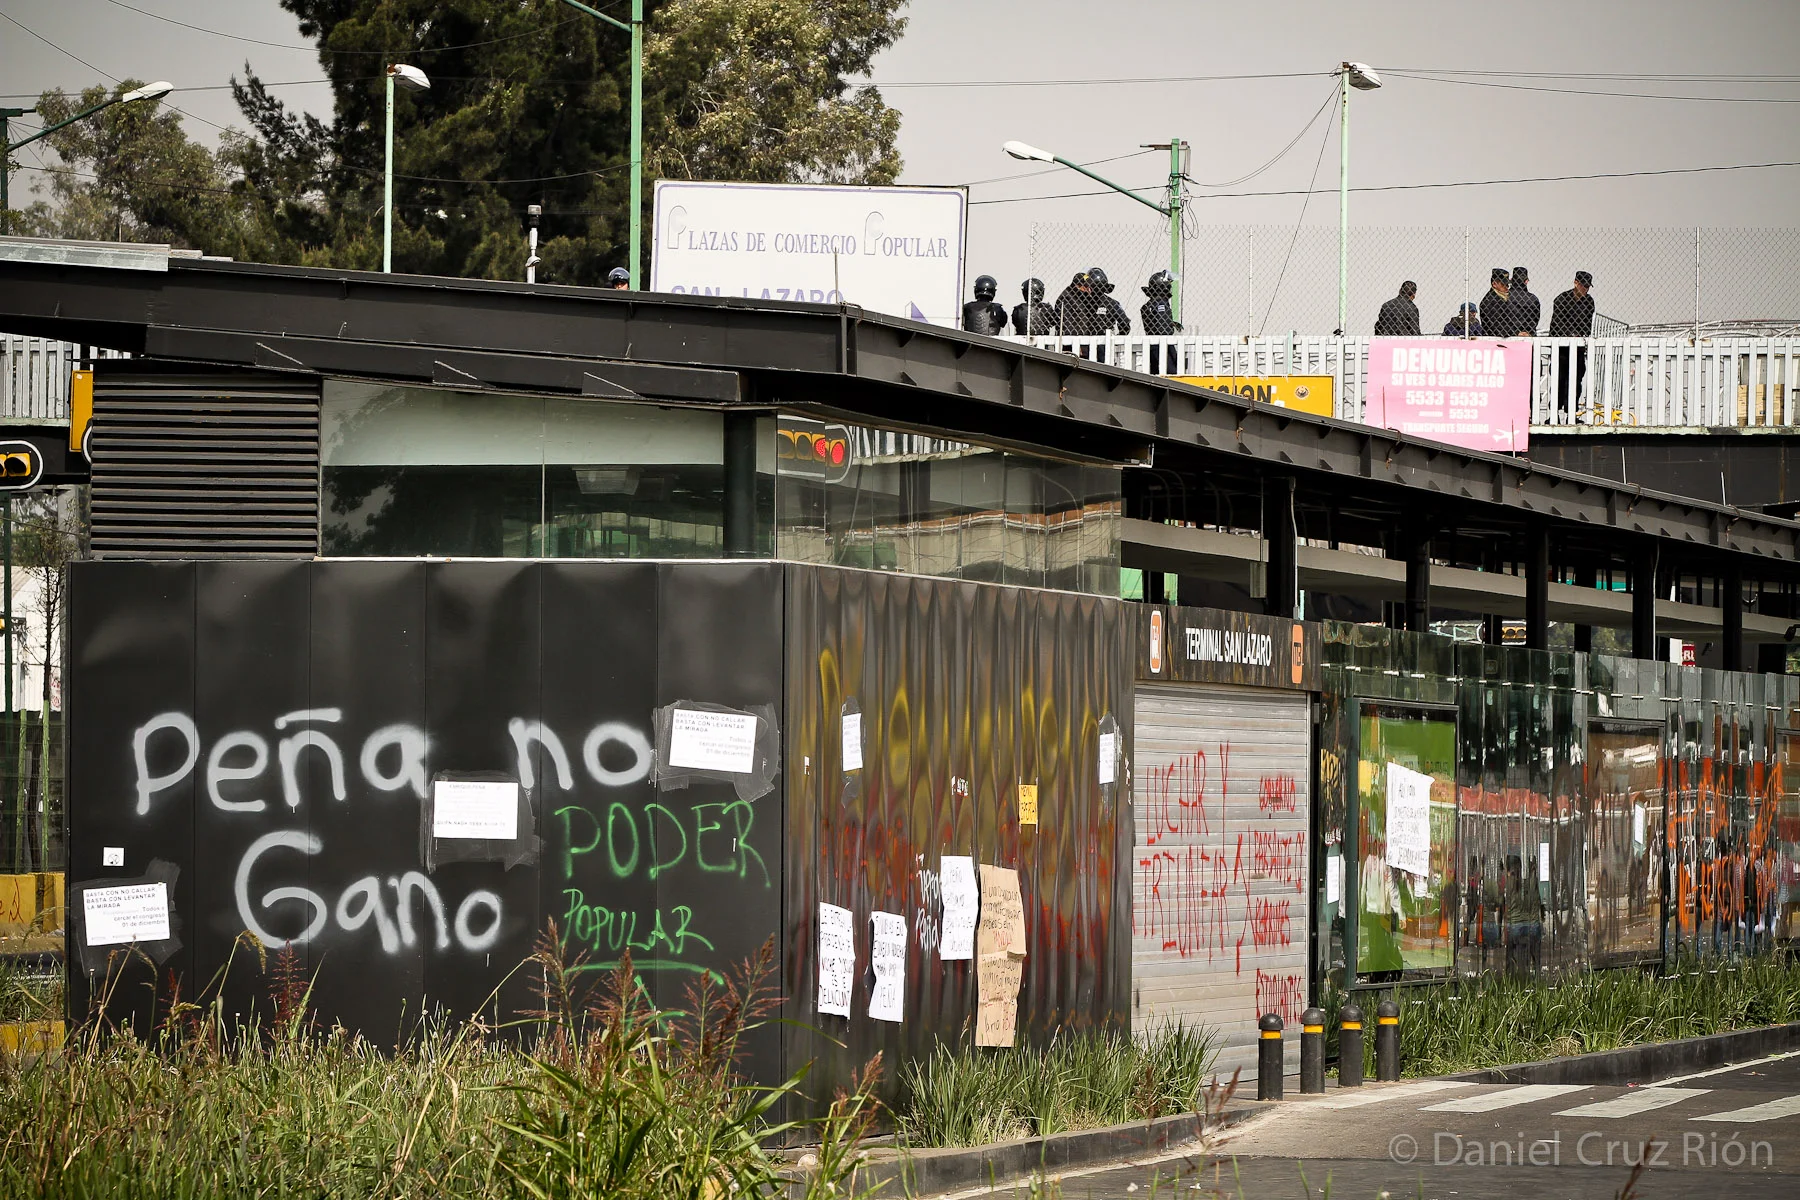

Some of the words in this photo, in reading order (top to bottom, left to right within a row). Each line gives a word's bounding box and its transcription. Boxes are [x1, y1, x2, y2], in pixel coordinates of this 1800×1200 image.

[667, 205, 738, 252] PLAZAS
[746, 232, 766, 252] DE
[774, 233, 857, 255] COMERCIO
[864, 211, 949, 258] POPULAR
[1391, 373, 1403, 386] SI
[1405, 374, 1426, 387] VES
[1428, 374, 1435, 387] O
[1438, 374, 1474, 387] SABES
[1476, 376, 1504, 388] ALGO
[1392, 348, 1506, 374] DENUNCIA
[1406, 390, 1445, 405] 5533
[1450, 391, 1489, 407] 5533
[1449, 409, 1478, 420] 5533
[1186, 627, 1223, 662] TERMINAL
[1225, 630, 1244, 664] SAN
[1242, 625, 1272, 667] LÁZARO
[133, 708, 429, 815] Peña
[509, 718, 653, 789] no
[1145, 752, 1208, 846] LUCHAR
[555, 801, 771, 888] PODER
[235, 831, 502, 953] Gano
[559, 888, 714, 954] POPULAR
[1139, 844, 1230, 965] TRIUNFAR
